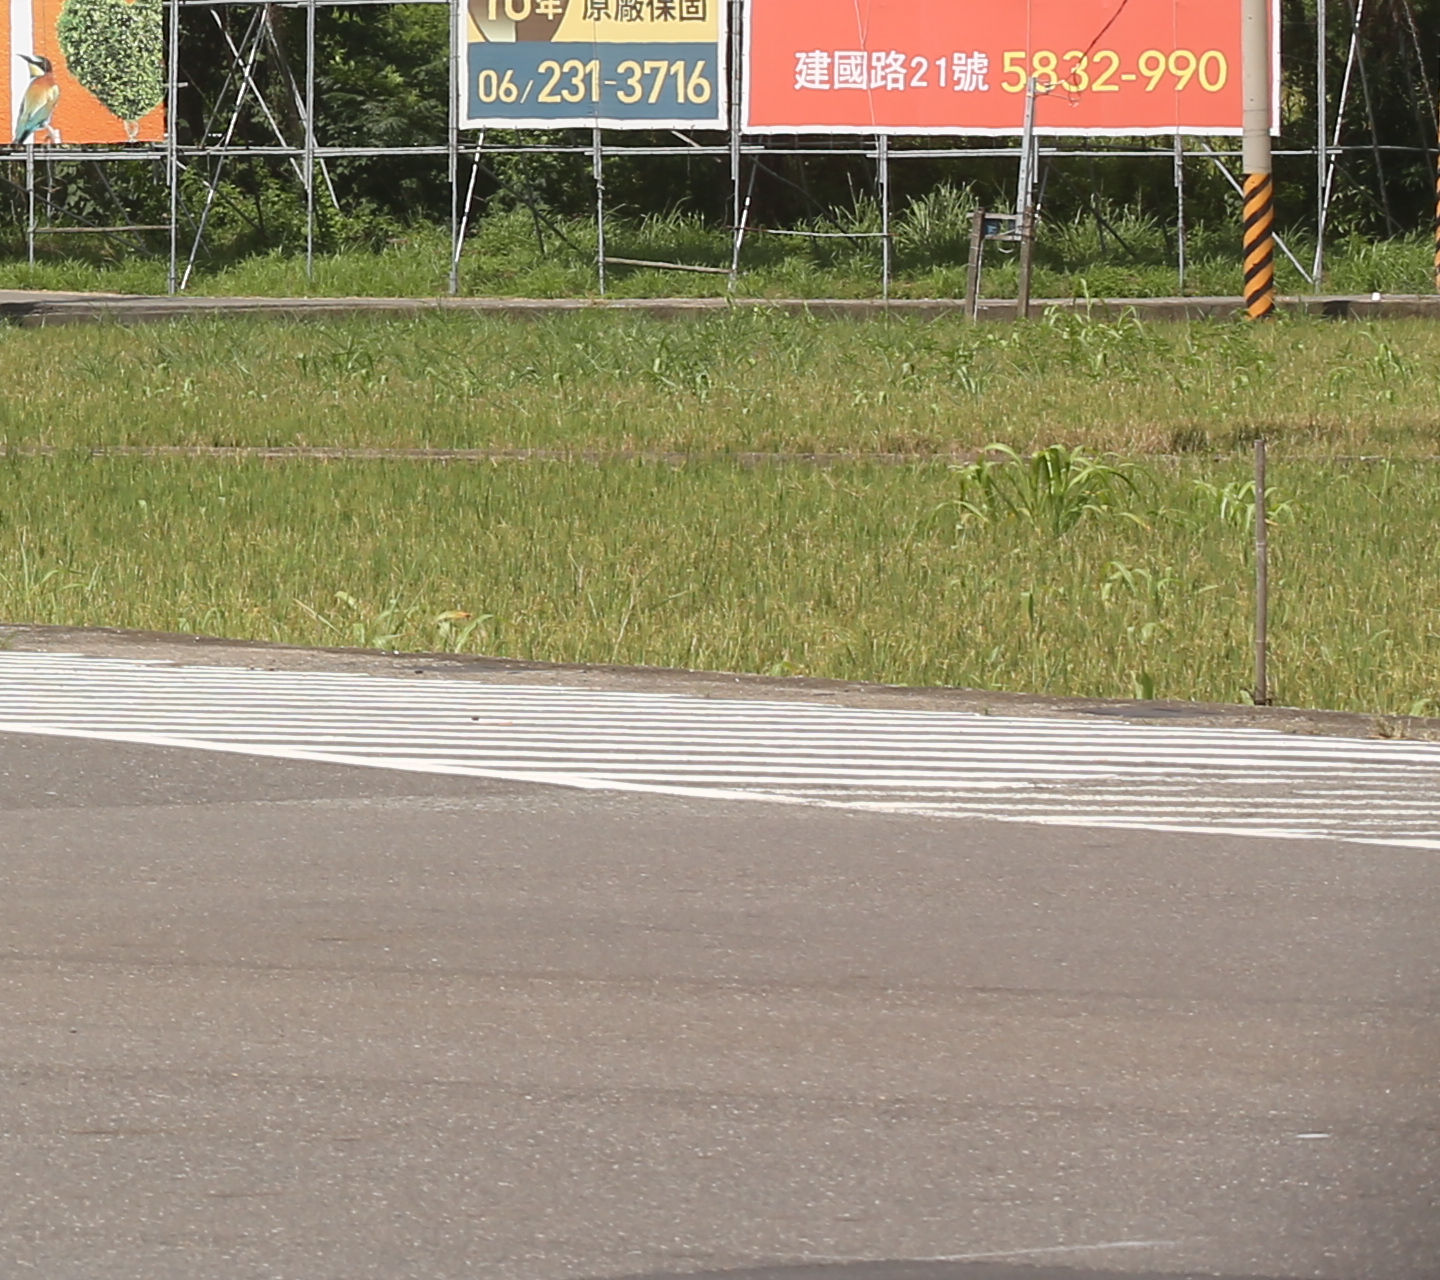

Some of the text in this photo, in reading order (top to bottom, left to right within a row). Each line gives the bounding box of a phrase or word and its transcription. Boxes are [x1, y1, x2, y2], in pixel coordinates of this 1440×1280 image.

[794, 51, 1228, 93] 建國路21號 5832-990
